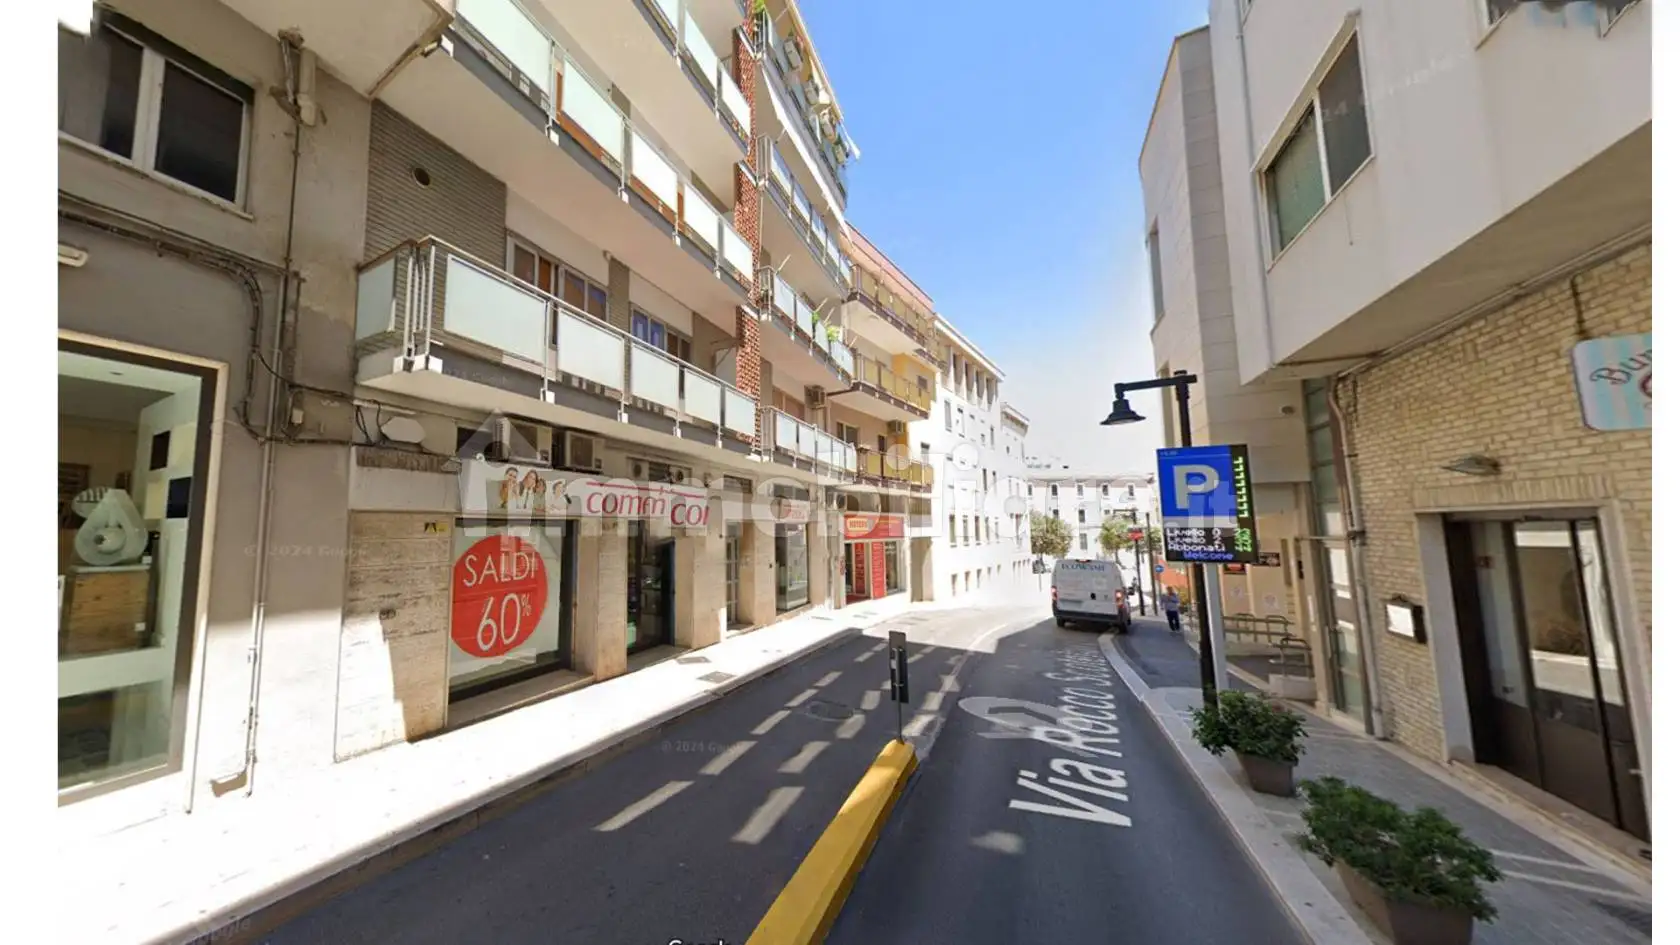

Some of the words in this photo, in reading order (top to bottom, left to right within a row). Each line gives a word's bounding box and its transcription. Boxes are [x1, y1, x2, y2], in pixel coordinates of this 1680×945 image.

[1172, 464, 1219, 510] P
[1167, 543, 1226, 553] Abbonati
[1184, 552, 1233, 560] Welcome
[463, 552, 536, 588] SALDI
